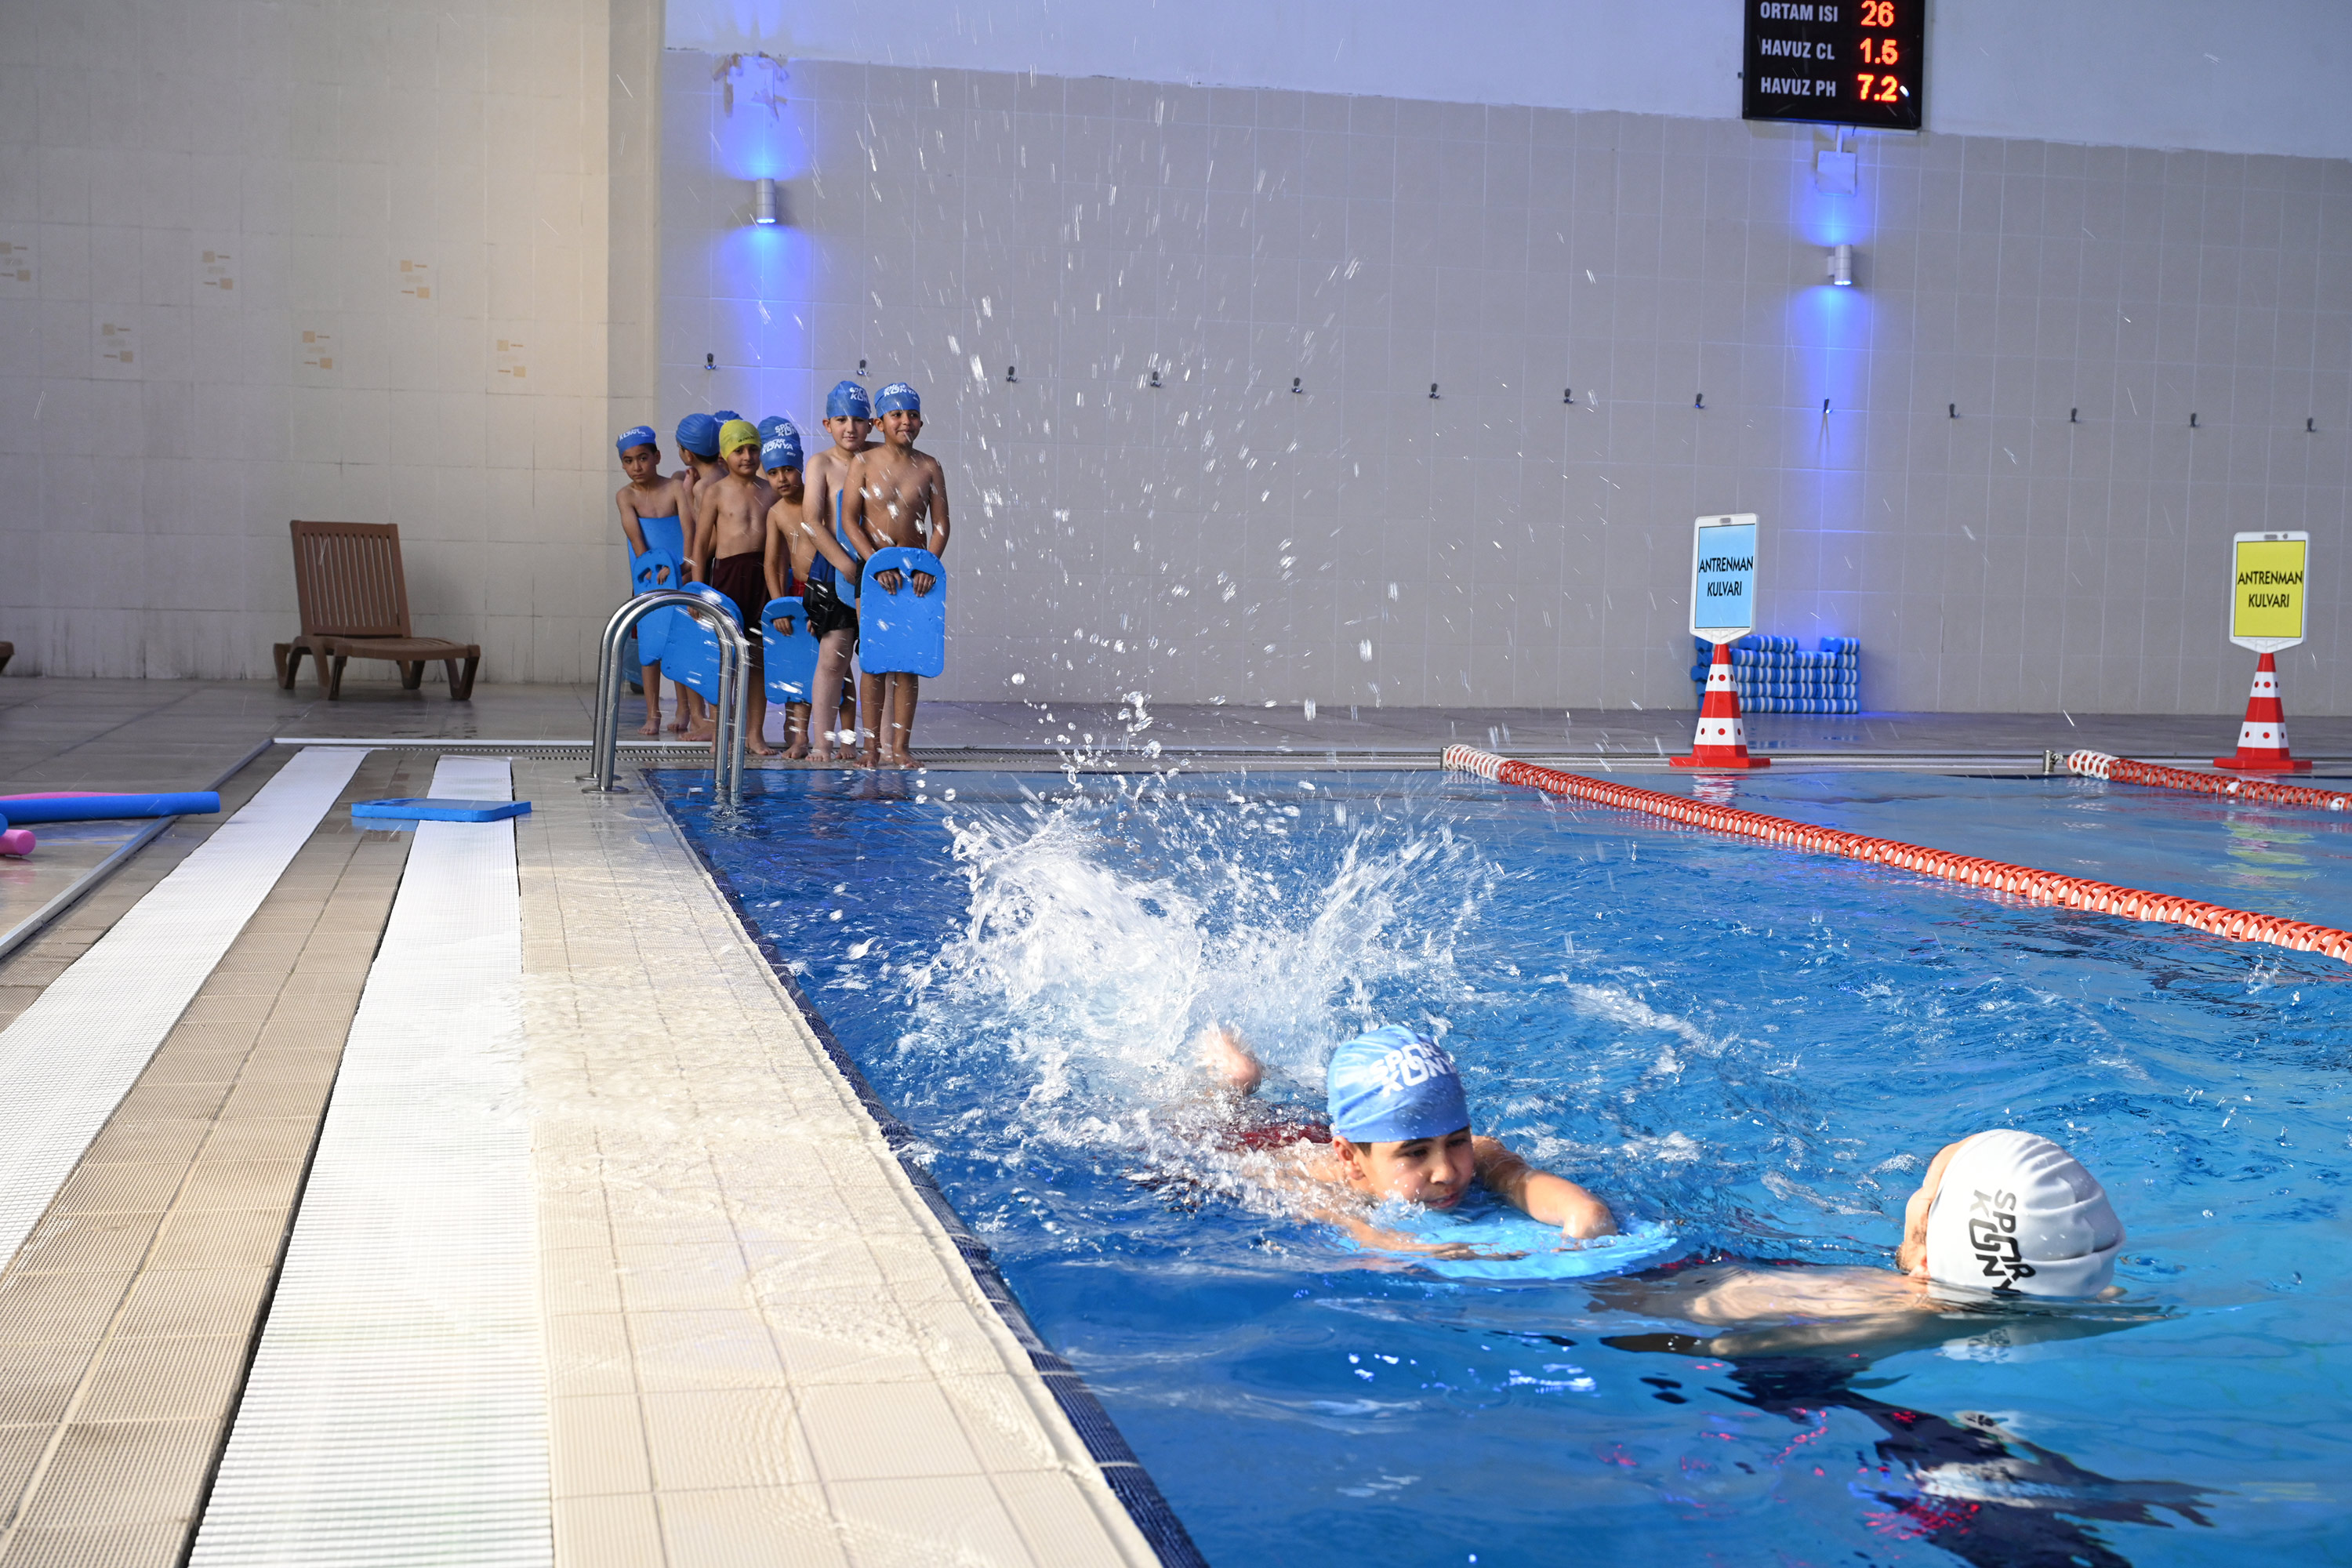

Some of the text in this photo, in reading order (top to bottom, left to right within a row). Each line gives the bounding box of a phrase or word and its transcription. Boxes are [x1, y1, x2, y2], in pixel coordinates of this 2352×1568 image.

[1760, 0, 1894, 27] ORTAM ISI 26
[1761, 38, 1898, 65] HAVUZ CL 1.5
[1760, 74, 1898, 102] HAVUZ PH 7.2
[1698, 556, 1754, 573] ANTRENMAN
[2238, 570, 2303, 585] ANTRENMAN
[1707, 581, 1742, 597] KULVARI
[2249, 593, 2290, 608] KULVARI
[1370, 1043, 1440, 1083] SPOR
[1381, 1055, 1457, 1098] KONY
[1968, 1189, 2022, 1294] KONY
[1984, 1189, 2036, 1282] SPOR
